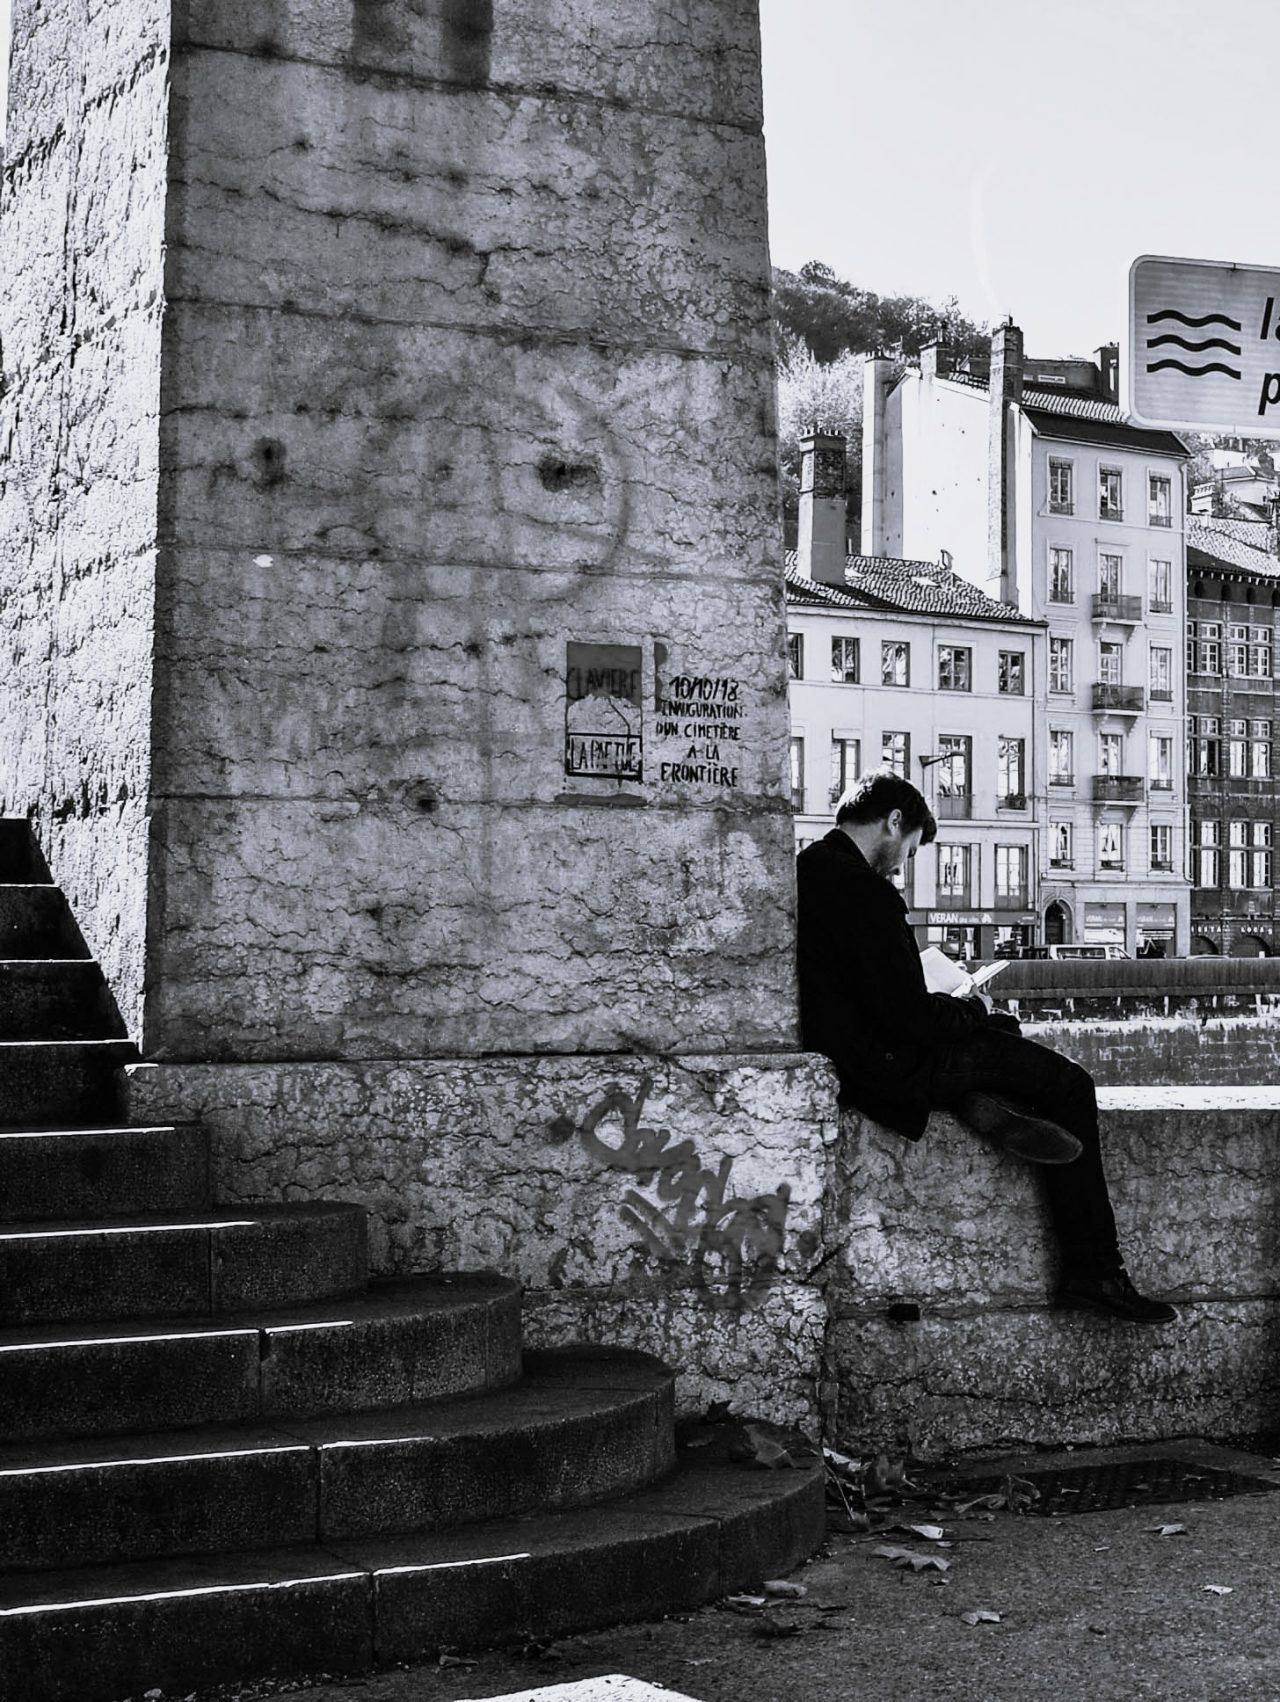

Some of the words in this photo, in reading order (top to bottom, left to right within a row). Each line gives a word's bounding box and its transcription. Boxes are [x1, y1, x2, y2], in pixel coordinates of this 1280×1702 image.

[669, 676, 739, 702] 10/10/18
[570, 737, 588, 770] LA
[706, 744, 720, 761] LA
[929, 913, 959, 924] VERAN
